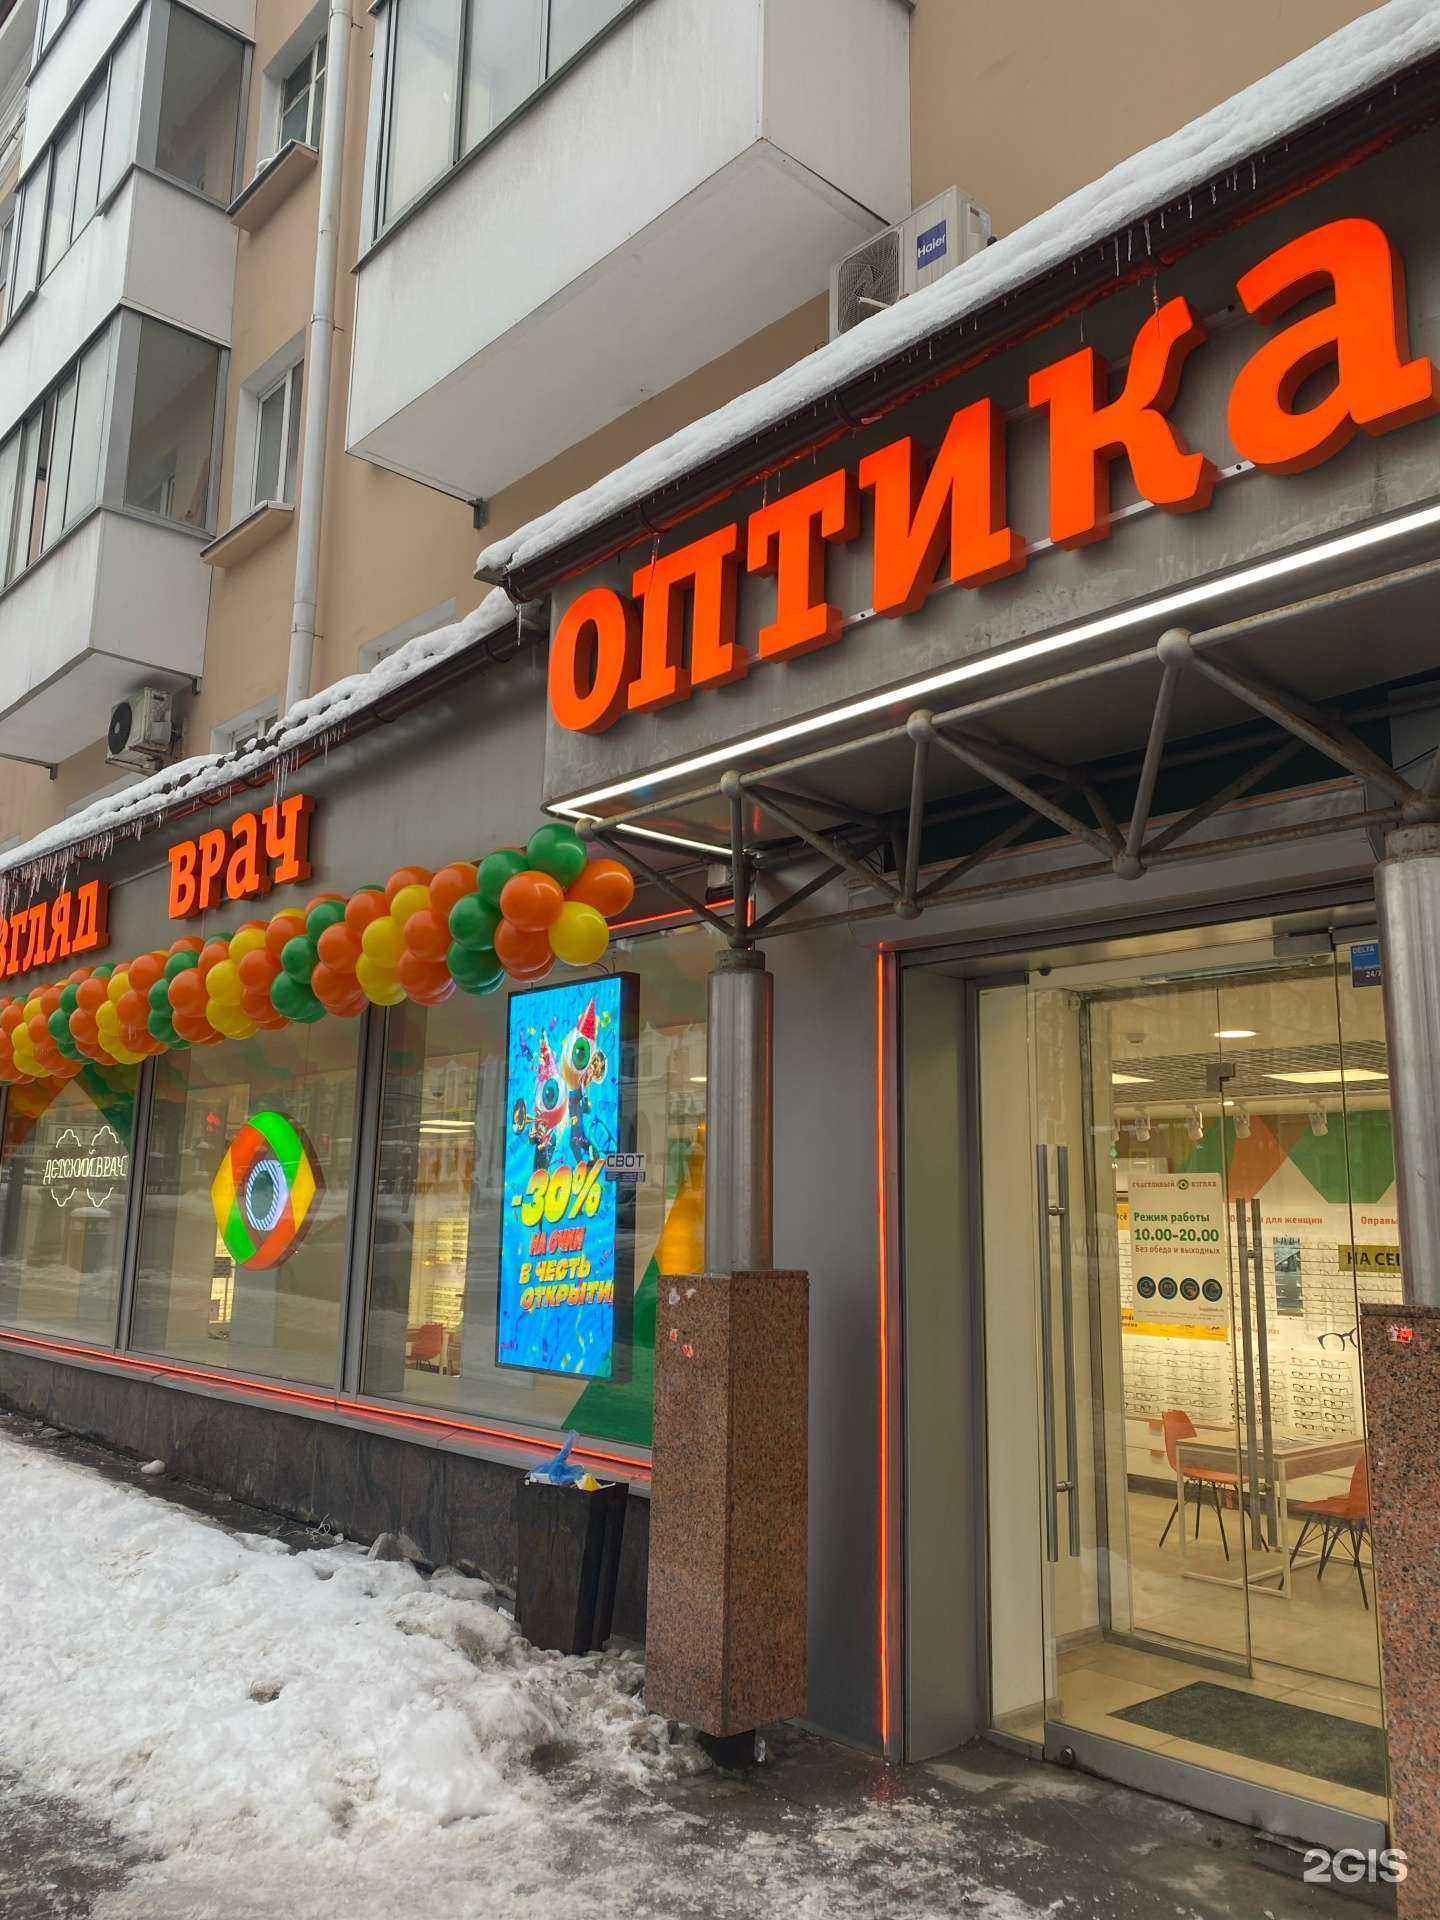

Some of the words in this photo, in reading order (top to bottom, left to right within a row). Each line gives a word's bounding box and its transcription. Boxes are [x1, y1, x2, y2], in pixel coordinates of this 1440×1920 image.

[917, 233, 946, 258] Haier
[511, 1159, 606, 1226] -30%
[1133, 1212, 1168, 1222] Режим
[1171, 1212, 1210, 1223] работы
[1284, 1217, 1323, 1226] женщин
[530, 1231, 547, 1256] НА
[550, 1227, 586, 1254] ОЧКИ
[1134, 1228, 1220, 1242] 10.00-20.00
[1135, 1244, 1149, 1253] Без
[1150, 1245, 1172, 1254] обеда
[1180, 1246, 1221, 1255] выходных
[1347, 1252, 1372, 1266] НА
[519, 1263, 532, 1284] В
[535, 1256, 591, 1283] ЧЕСТЬ
